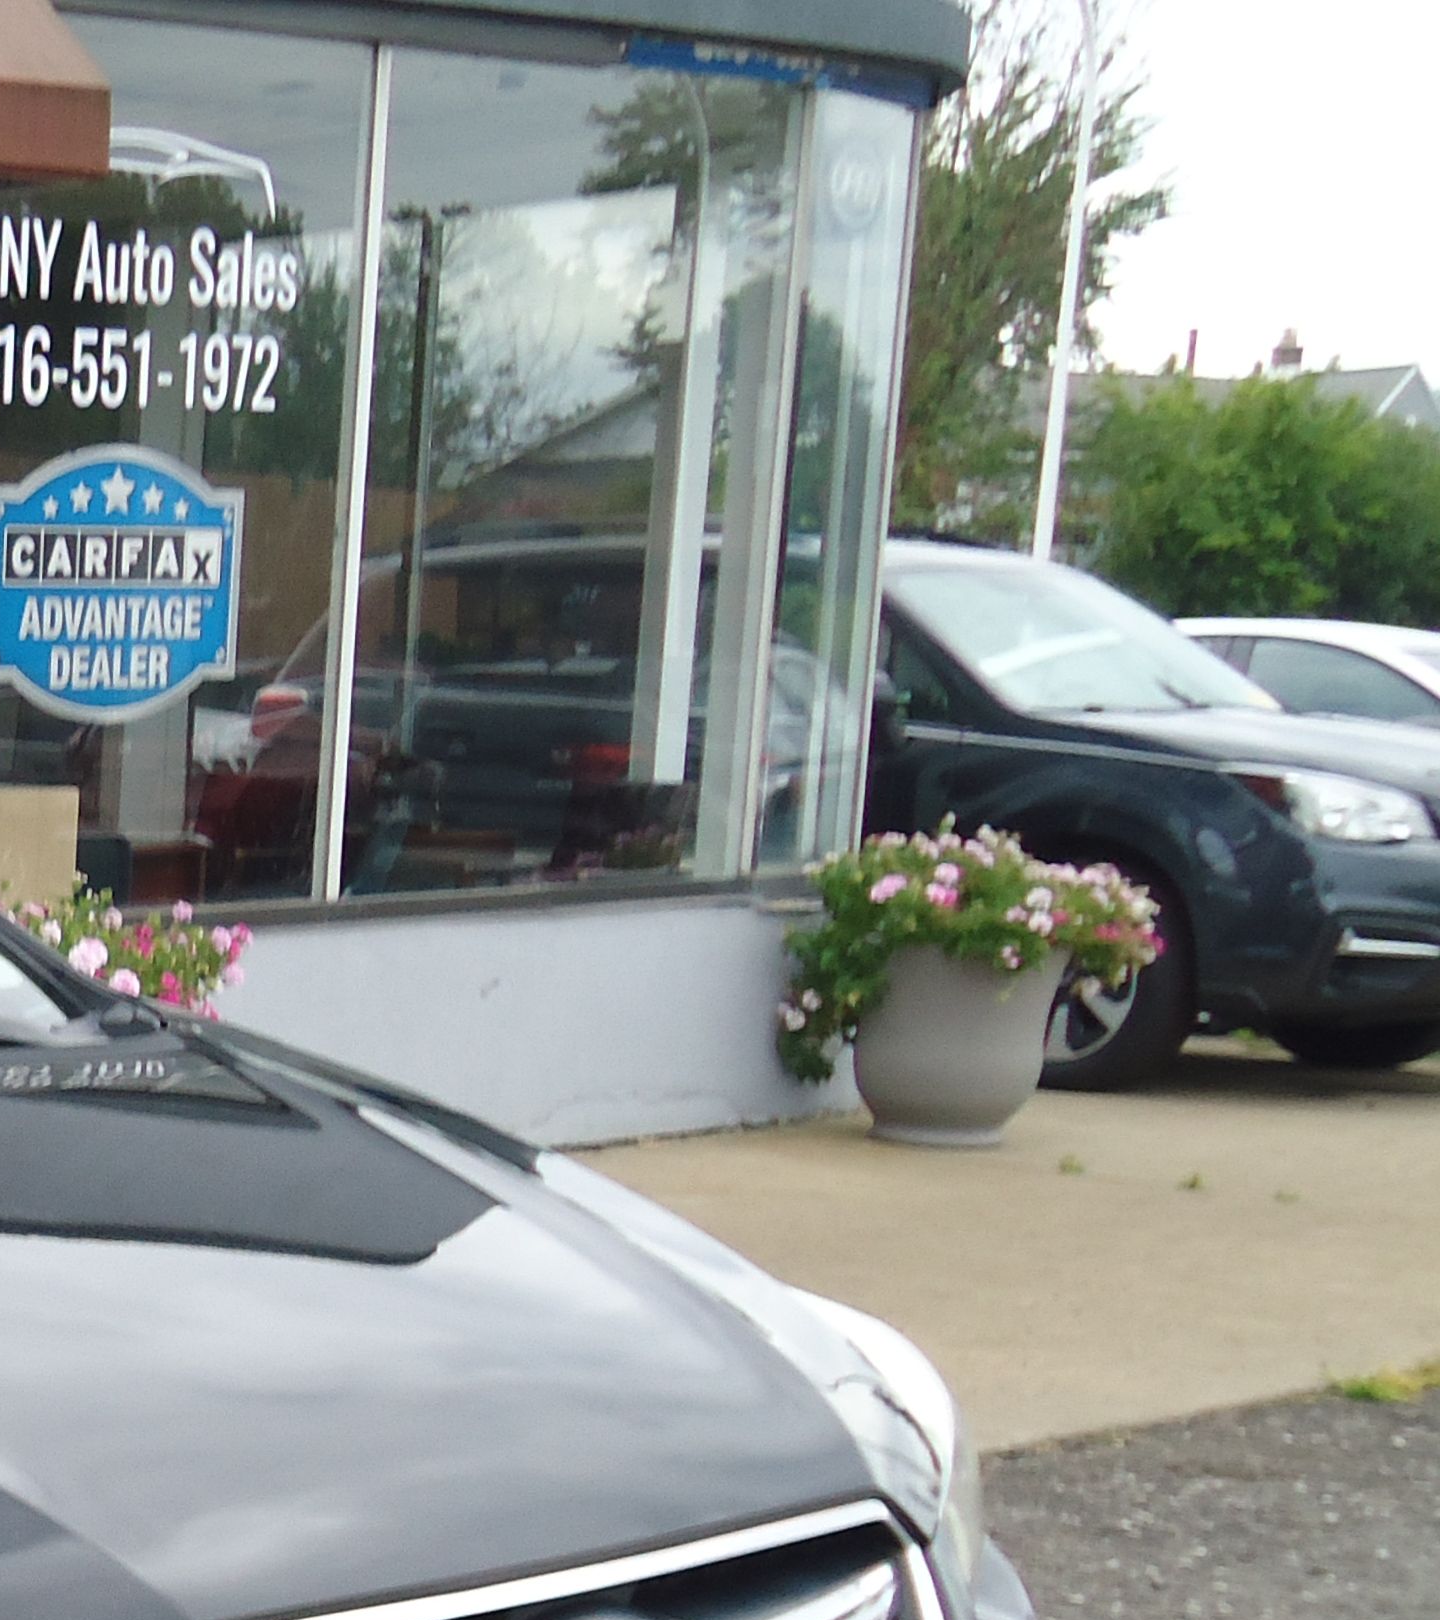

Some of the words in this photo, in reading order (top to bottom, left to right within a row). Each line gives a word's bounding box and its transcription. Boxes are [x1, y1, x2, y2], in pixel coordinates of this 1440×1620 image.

[73, 220, 175, 306] Auto
[188, 225, 298, 311] Sales
[9, 533, 215, 583] CARFAX
[19, 595, 203, 642] ADVANTAGE
[49, 645, 169, 691] DEALER
